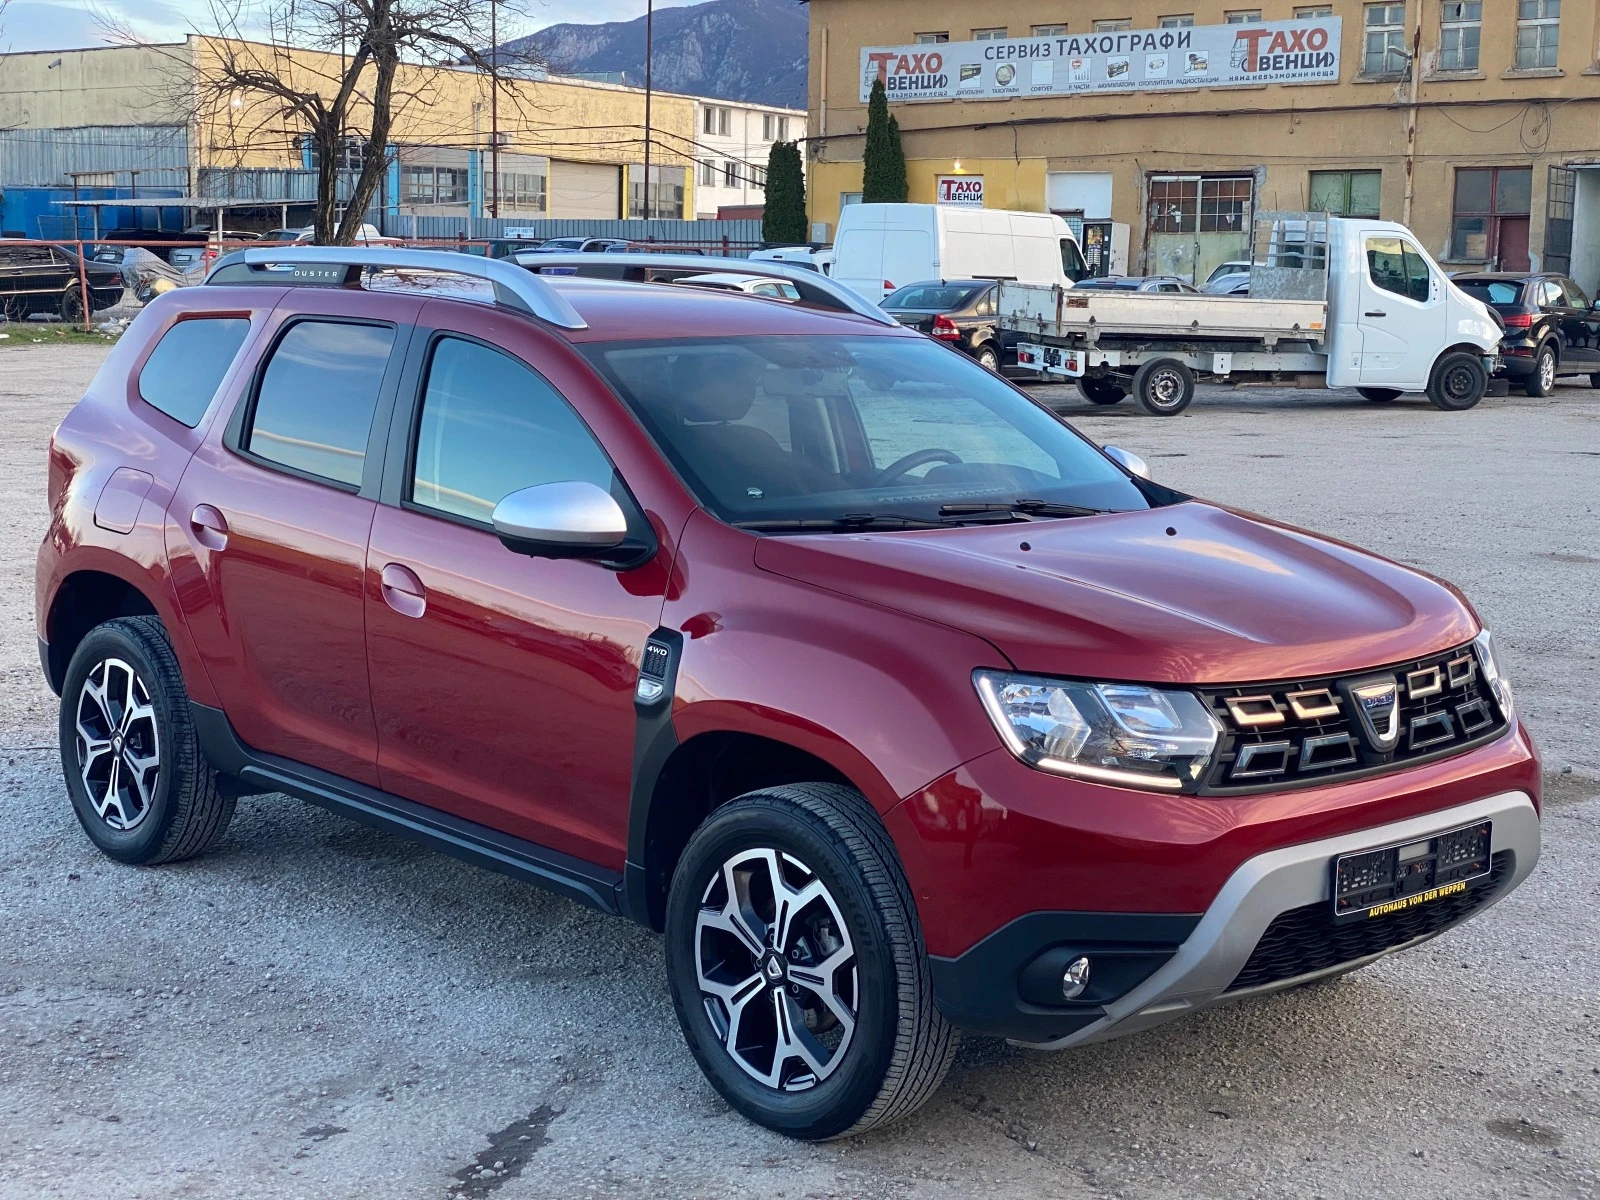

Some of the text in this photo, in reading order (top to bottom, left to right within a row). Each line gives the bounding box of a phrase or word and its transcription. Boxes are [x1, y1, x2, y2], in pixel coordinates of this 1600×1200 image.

[984, 30, 1192, 60] СЕРВИЗ ТАХОГРАФИ
[1236, 28, 1328, 72] ТАХО
[869, 52, 943, 88] ТАХО
[1259, 52, 1330, 72] ВЕНЦИ
[887, 74, 943, 91] ВЕНЦИ
[941, 180, 982, 200] ТАХО
[951, 193, 983, 201] ВЕНЦИ
[647, 646, 667, 656] 4WD
[1368, 881, 1466, 918] AUTOHAUS VON DER WEPPEN
